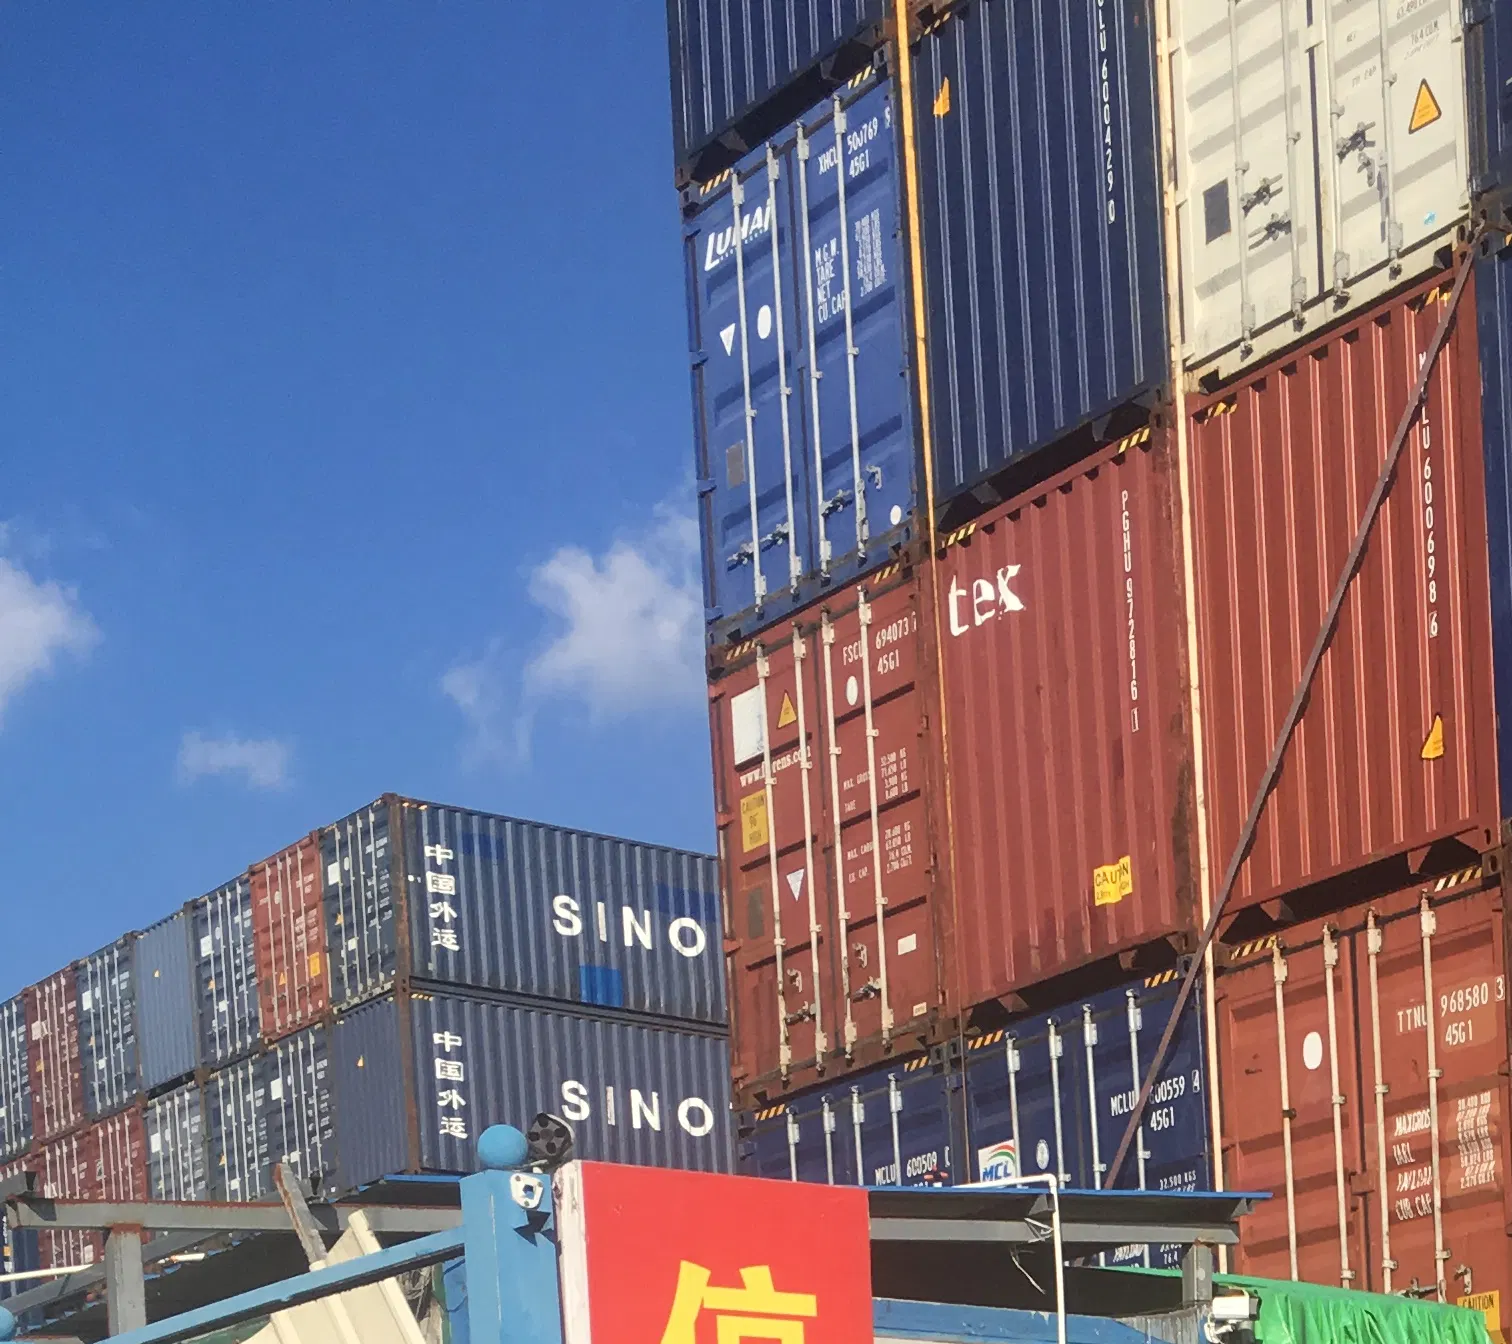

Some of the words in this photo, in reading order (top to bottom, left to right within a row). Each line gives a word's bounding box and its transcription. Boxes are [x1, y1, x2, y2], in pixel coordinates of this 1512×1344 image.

[1101, 58, 1114, 192] 600429
[849, 150, 870, 178] 45G1
[1121, 490, 1132, 573] PGHU
[1423, 457, 1437, 603] 600698
[875, 621, 909, 650] 694073
[1126, 577, 1138, 701] 972816
[1429, 611, 1438, 638] 6
[877, 648, 900, 675] 45G1
[424, 843, 461, 952] 中国外运
[552, 894, 707, 958] SINO
[1439, 982, 1489, 1018] 968580
[1495, 976, 1504, 1001] 3
[1445, 1019, 1473, 1046] 45G1
[433, 1030, 469, 1140] 中国外运
[560, 1079, 715, 1137] SINO
[1150, 1107, 1175, 1132] 45G1
[982, 1160, 1012, 1182] MCL
